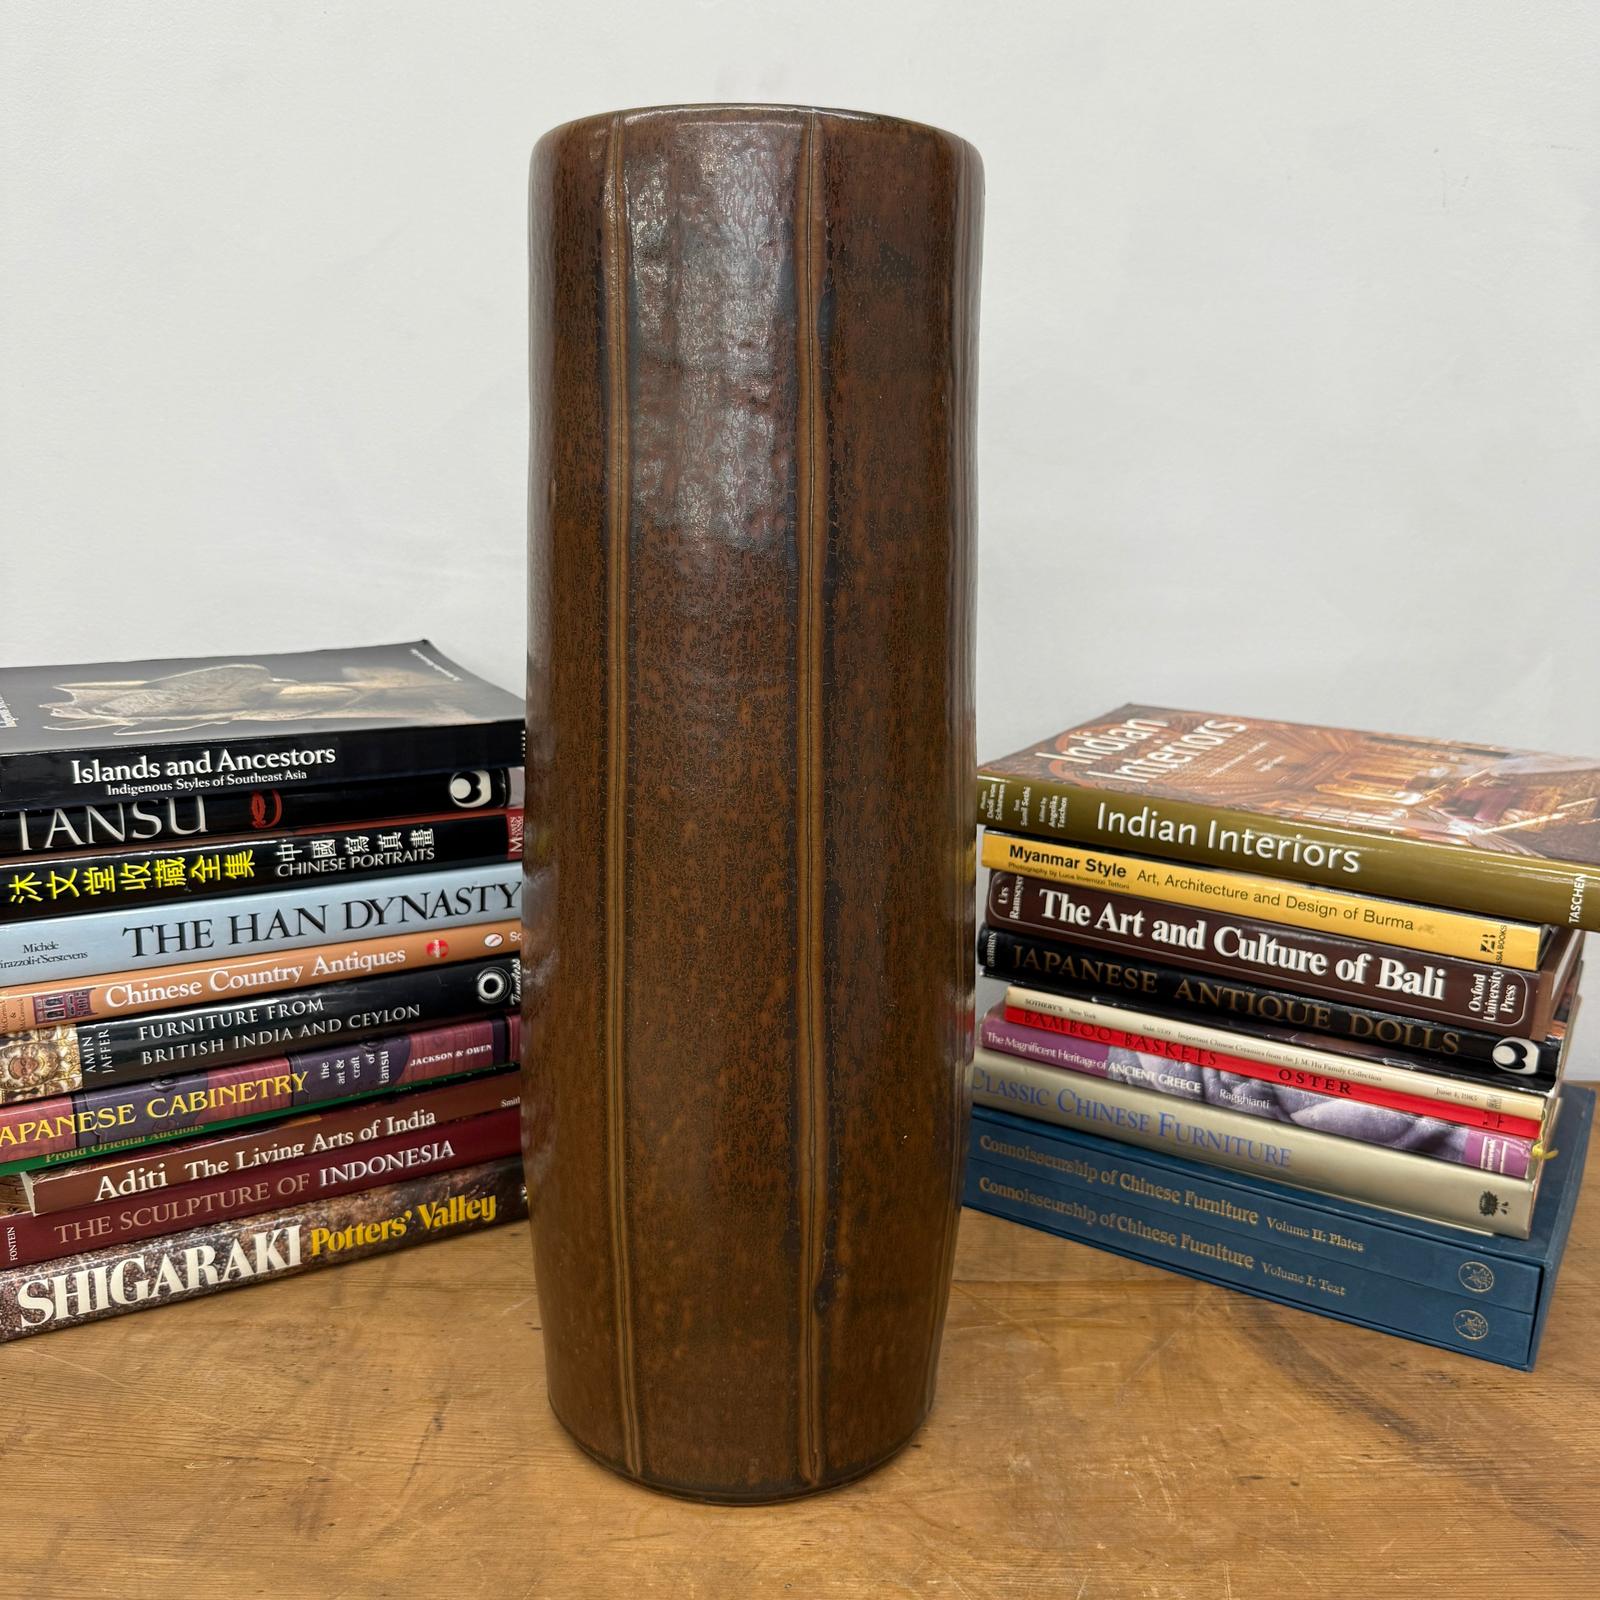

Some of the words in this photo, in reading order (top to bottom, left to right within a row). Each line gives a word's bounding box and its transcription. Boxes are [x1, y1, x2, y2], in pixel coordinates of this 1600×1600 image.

[71, 755, 161, 785] Islands
[166, 751, 212, 777] and
[216, 748, 336, 773] Ancestors
[1035, 718, 1168, 764] Indian
[1087, 719, 1247, 783] Interiors
[107, 783, 173, 797] Indigenous
[176, 777, 210, 791] Styles
[213, 775, 225, 787] of
[226, 771, 283, 786] Southeast
[285, 770, 308, 782] Asia
[277, 857, 347, 877] CHINESE
[350, 848, 435, 870] PORTRAITS
[1097, 802, 1197, 846] Indian
[1207, 820, 1362, 873] Interiors
[8, 849, 255, 903] 沐文堂收藏全集
[1009, 845, 1080, 869] Myanmar
[1085, 859, 1127, 877] Style
[1137, 869, 1160, 886] Art,
[1164, 873, 1249, 900] Architecture
[1253, 893, 1280, 907] and
[1285, 895, 1338, 918] Design
[1343, 907, 1359, 920] of
[1363, 909, 1414, 931] Burma
[1568, 873, 1586, 924] TASCHEN
[122, 919, 215, 958] THE
[227, 904, 329, 945] HAN
[342, 882, 522, 931] DYNASTY
[1039, 888, 1091, 926] The
[1094, 902, 1146, 938] Art
[1152, 920, 1205, 951] and
[1213, 925, 1328, 976] Culture
[1335, 953, 1373, 985] of
[1375, 957, 1447, 1000] Bali
[105, 982, 202, 1008] Chinese
[209, 966, 303, 993] Country
[311, 949, 406, 977] Antiques
[1013, 945, 1158, 993] JAPANESE
[1174, 978, 1331, 1029] ANTIQUE
[1350, 1013, 1460, 1055] DOLLS
[1468, 973, 1486, 1012] Oxford
[1482, 969, 1505, 1021] University
[1500, 984, 1516, 1013] Press
[139, 1008, 259, 1041] FURNITURE
[267, 998, 325, 1020] FROM
[142, 1038, 225, 1065] BRITISH
[234, 1025, 294, 1049] INDIA
[300, 1018, 343, 1038] AND
[349, 1004, 421, 1029] CEYLON
[82, 1036, 97, 1073] AMIN
[99, 1029, 116, 1074] JAFFER
[321, 1061, 330, 1079] the
[336, 1059, 345, 1069] &
[350, 1056, 360, 1078] craft
[366, 1053, 375, 1064] of
[410, 1051, 453, 1066] JACKSON
[456, 1049, 464, 1057] &
[466, 1043, 492, 1056] OWEN
[986, 1031, 1004, 1044] The
[1004, 1036, 1057, 1057] Magnificent
[1058, 1049, 1096, 1068] Heritage
[1096, 1059, 1106, 1070] of
[1108, 1061, 1156, 1082] ANCIENT
[1158, 1071, 1201, 1093] GREECE
[1219, 1088, 1270, 1109] Ragghianti
[1023, 1009, 1112, 1041] BAMBOO
[1124, 1028, 1216, 1065] BASKETS
[1278, 1068, 1352, 1095] OSTER
[147, 1071, 308, 1118] CABINETRY
[337, 1071, 345, 1084] art
[973, 1066, 1049, 1106] CLASSIC
[1057, 1087, 1150, 1132] CHINESE
[1158, 1111, 1291, 1169] FURNITURE
[94, 1162, 169, 1201] Aditi
[184, 1157, 229, 1180] The
[236, 1140, 304, 1169] Living
[312, 1132, 354, 1153] Arts
[359, 1120, 381, 1141] of
[386, 1109, 436, 1135] India
[54, 1215, 113, 1245] THE
[120, 1182, 271, 1231] SCULPTURE
[277, 1173, 311, 1195] OF
[319, 1140, 455, 1188] INDONESIA
[979, 1134, 1097, 1183] Connoisseurship
[1100, 1169, 1119, 1186] of
[1119, 1172, 1181, 1204] Chinese
[1184, 1189, 1259, 1226] Furniture
[1266, 1216, 1310, 1238] Volume
[1329, 1232, 1364, 1253] Plates
[7, 1226, 18, 1261] FONTEIN
[17, 1224, 302, 1328] SHIGARAKI
[309, 1209, 412, 1257] Potters'
[417, 1194, 497, 1231] Valley
[979, 1176, 1096, 1225] Connoisseurship
[1100, 1211, 1117, 1228] of
[1116, 1215, 1176, 1246] Chinese
[1180, 1232, 1255, 1269] Furniture
[1262, 1263, 1305, 1285] Volume
[1319, 1278, 1347, 1297] Text
